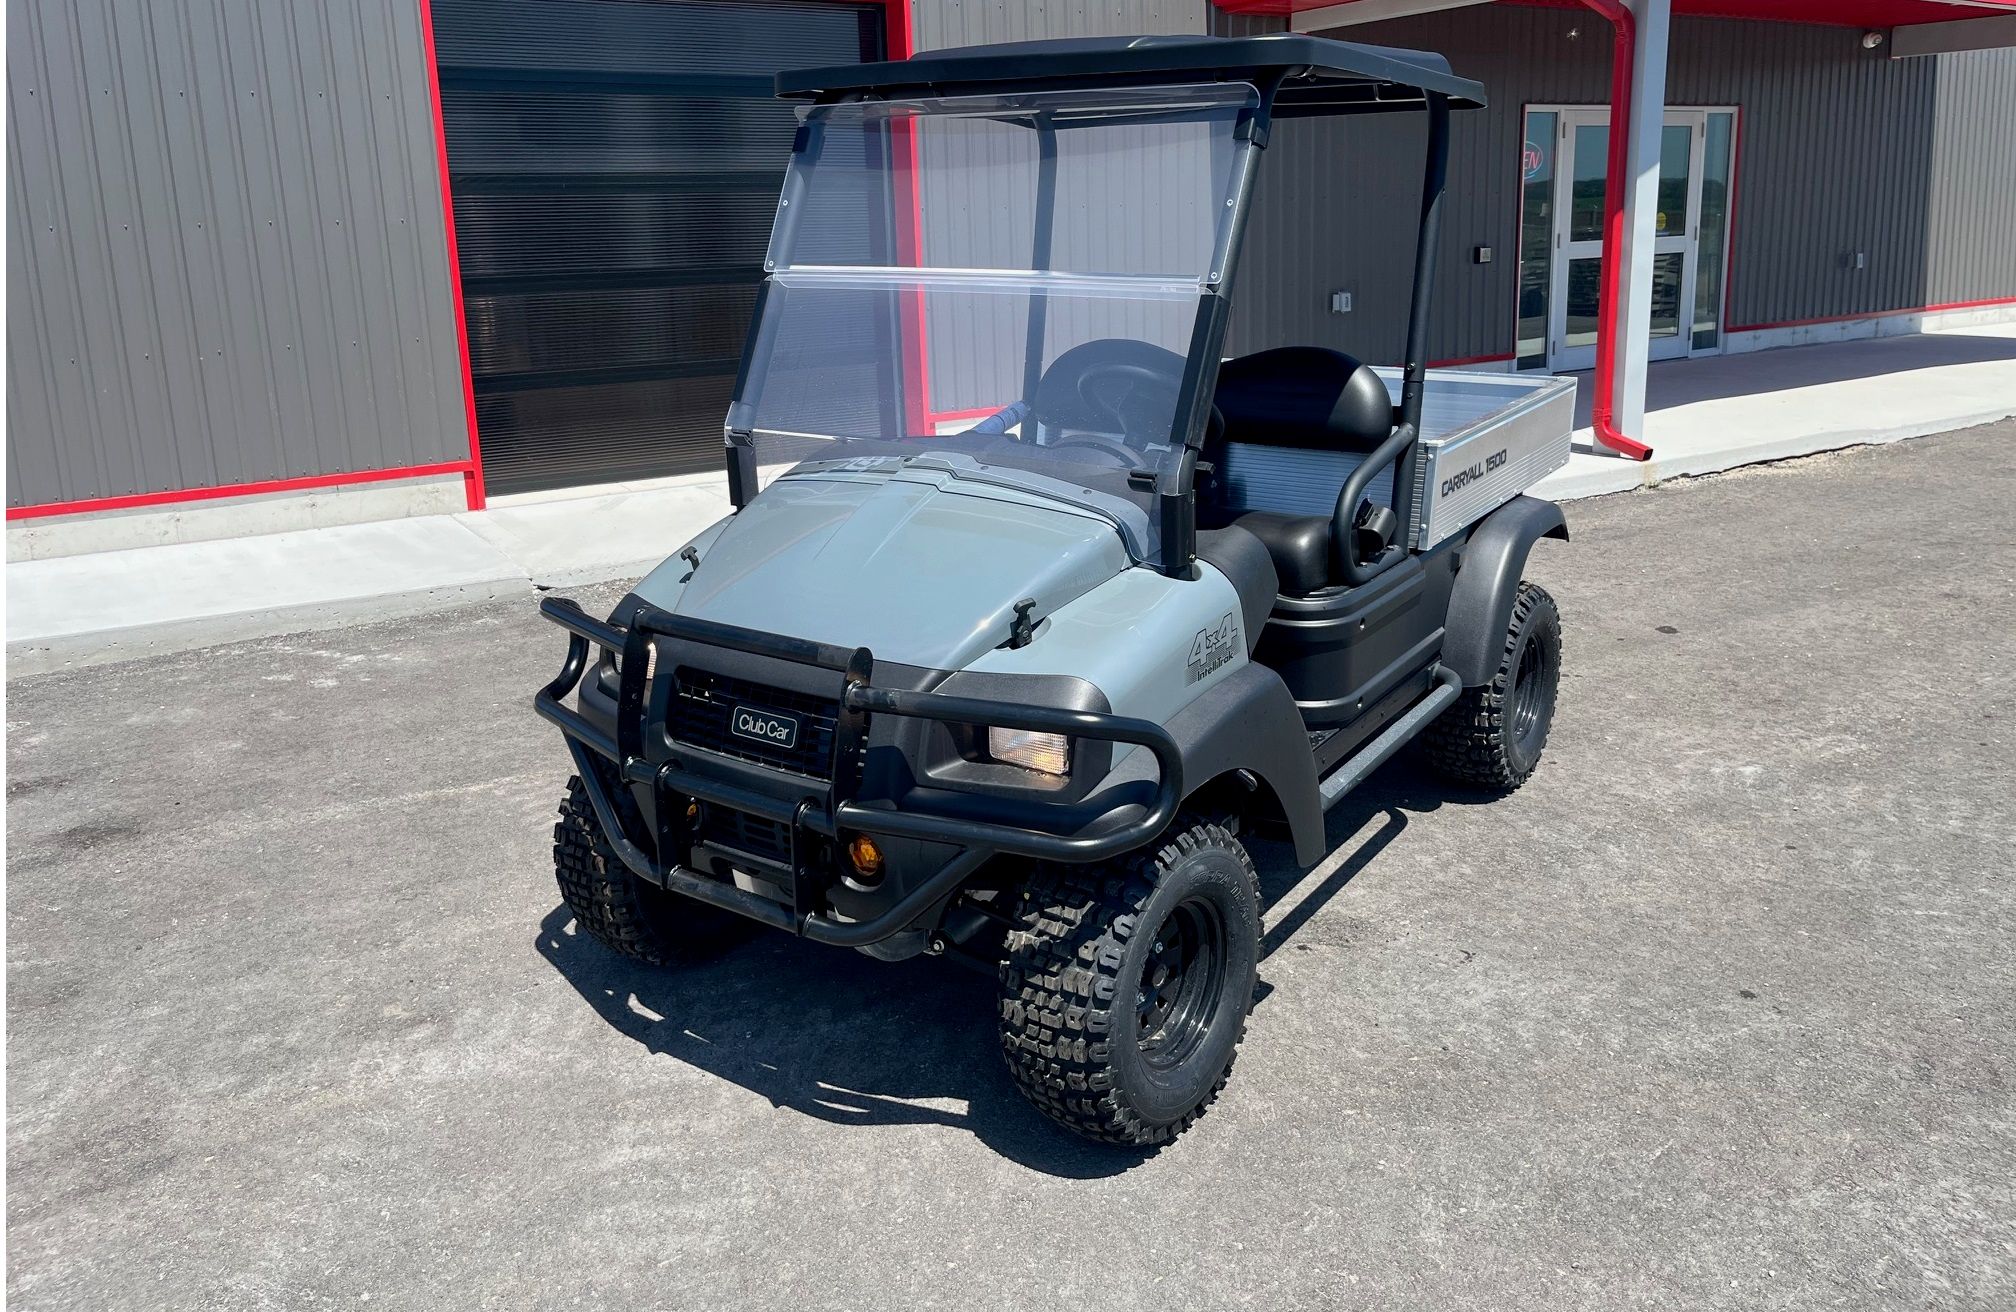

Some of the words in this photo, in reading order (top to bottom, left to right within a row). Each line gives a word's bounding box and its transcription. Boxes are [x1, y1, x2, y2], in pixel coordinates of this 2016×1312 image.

[1523, 151, 1541, 169] EN
[1441, 462, 1484, 498] CARRYALL
[1485, 448, 1507, 474] 1500
[1187, 611, 1238, 668] 4x4
[1197, 651, 1234, 682] IntelliTrak
[739, 713, 766, 735] Club
[767, 720, 790, 740] Car
